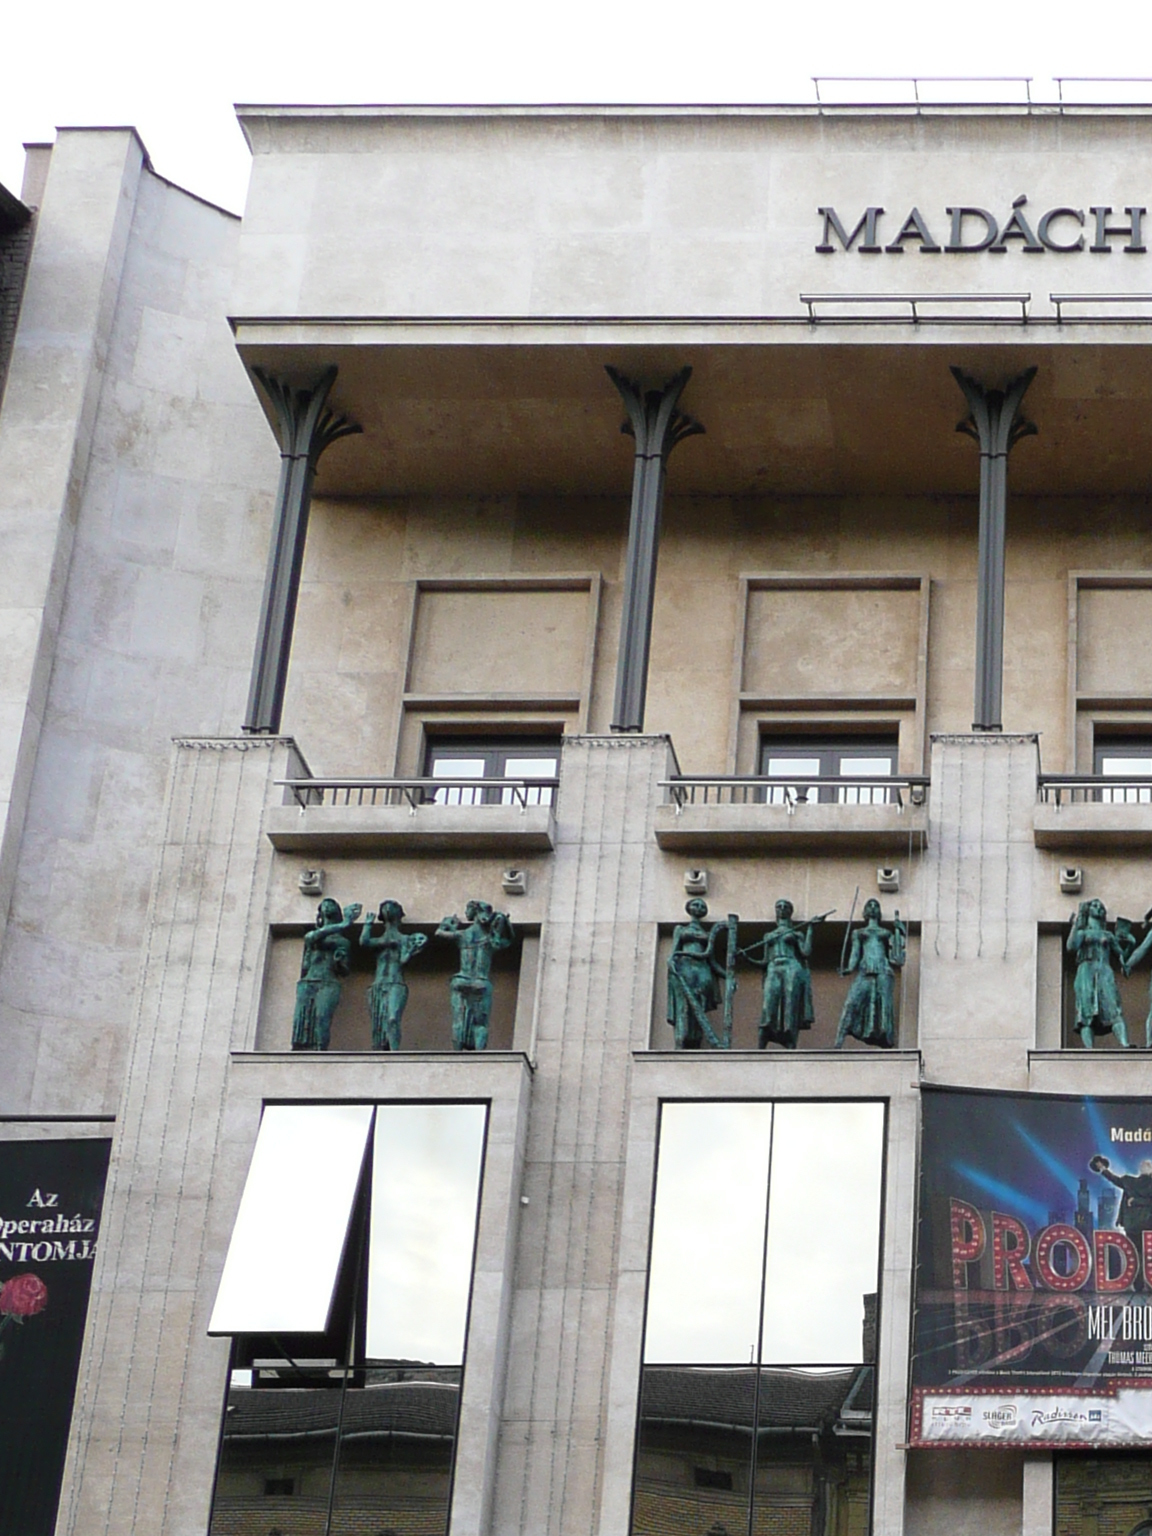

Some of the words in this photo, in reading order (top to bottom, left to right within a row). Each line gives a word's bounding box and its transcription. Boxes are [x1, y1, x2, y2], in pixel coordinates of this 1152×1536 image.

[815, 194, 1146, 254] MADÁCH
[26, 1188, 59, 1208] Az
[0, 1213, 95, 1239] peraház
[1088, 1305, 1116, 1341] MEL
[1108, 1352, 1134, 1365] THOMAS
